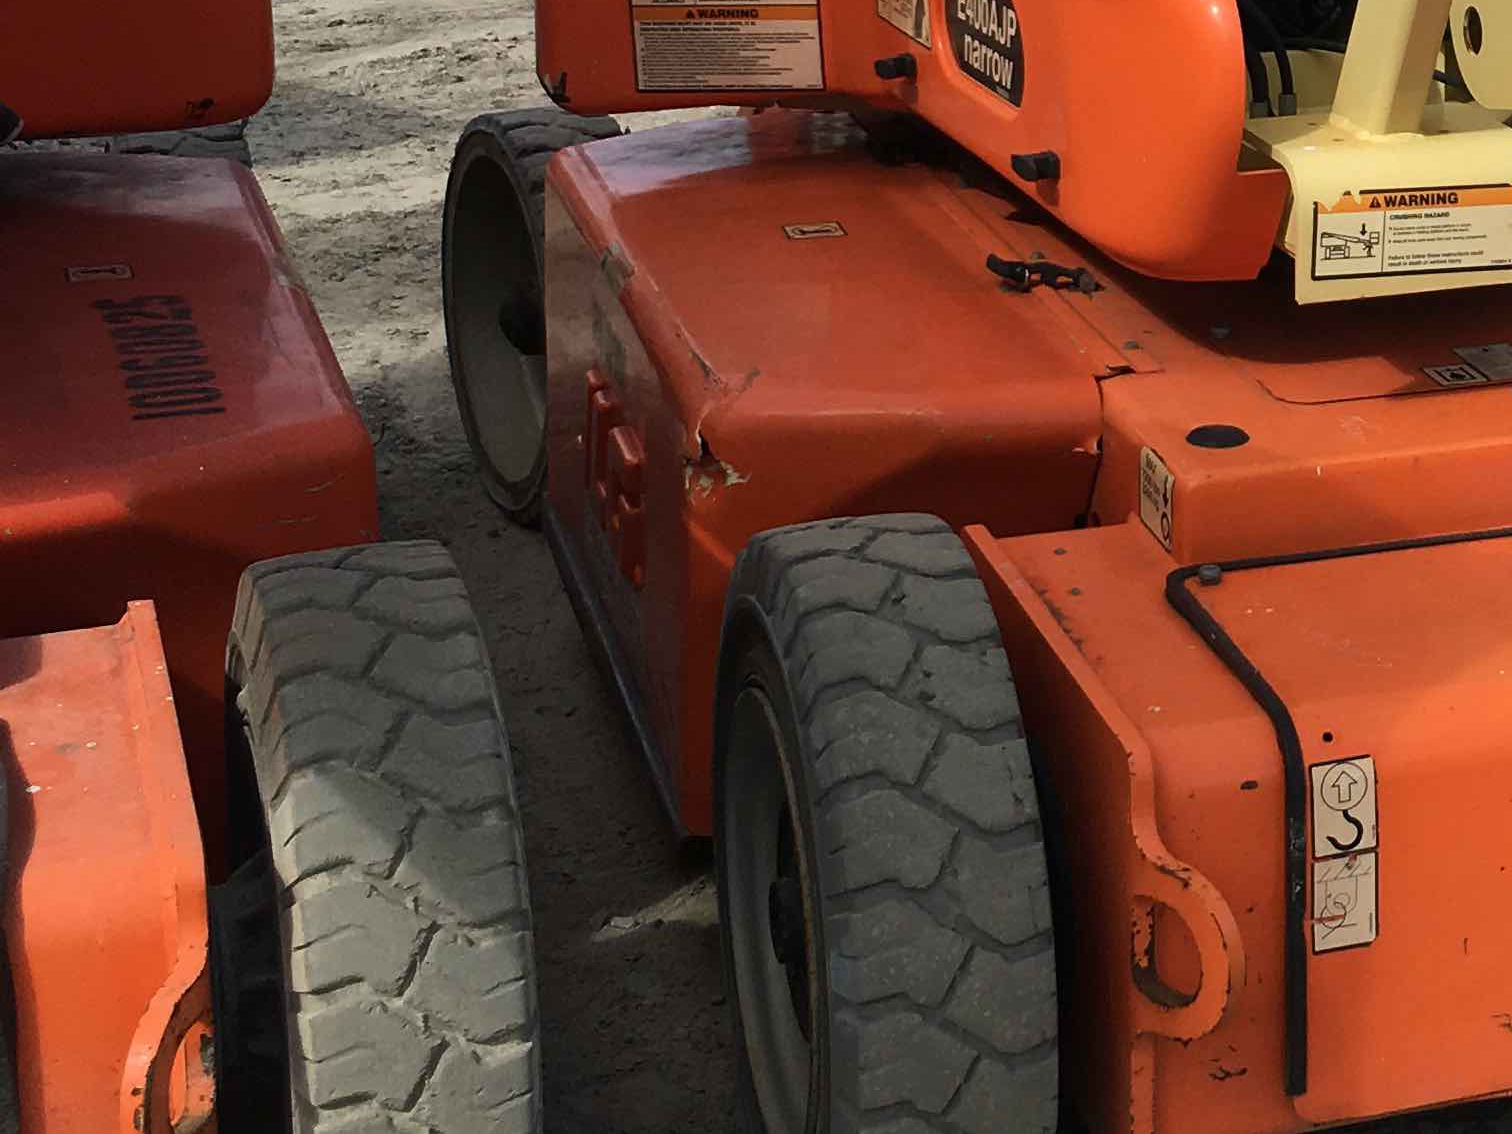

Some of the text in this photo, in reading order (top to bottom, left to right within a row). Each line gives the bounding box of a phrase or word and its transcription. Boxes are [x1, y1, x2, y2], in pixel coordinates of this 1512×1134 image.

[698, 8, 760, 19] WARNING
[963, 34, 1014, 91] narrow
[1383, 192, 1459, 208] WARNING
